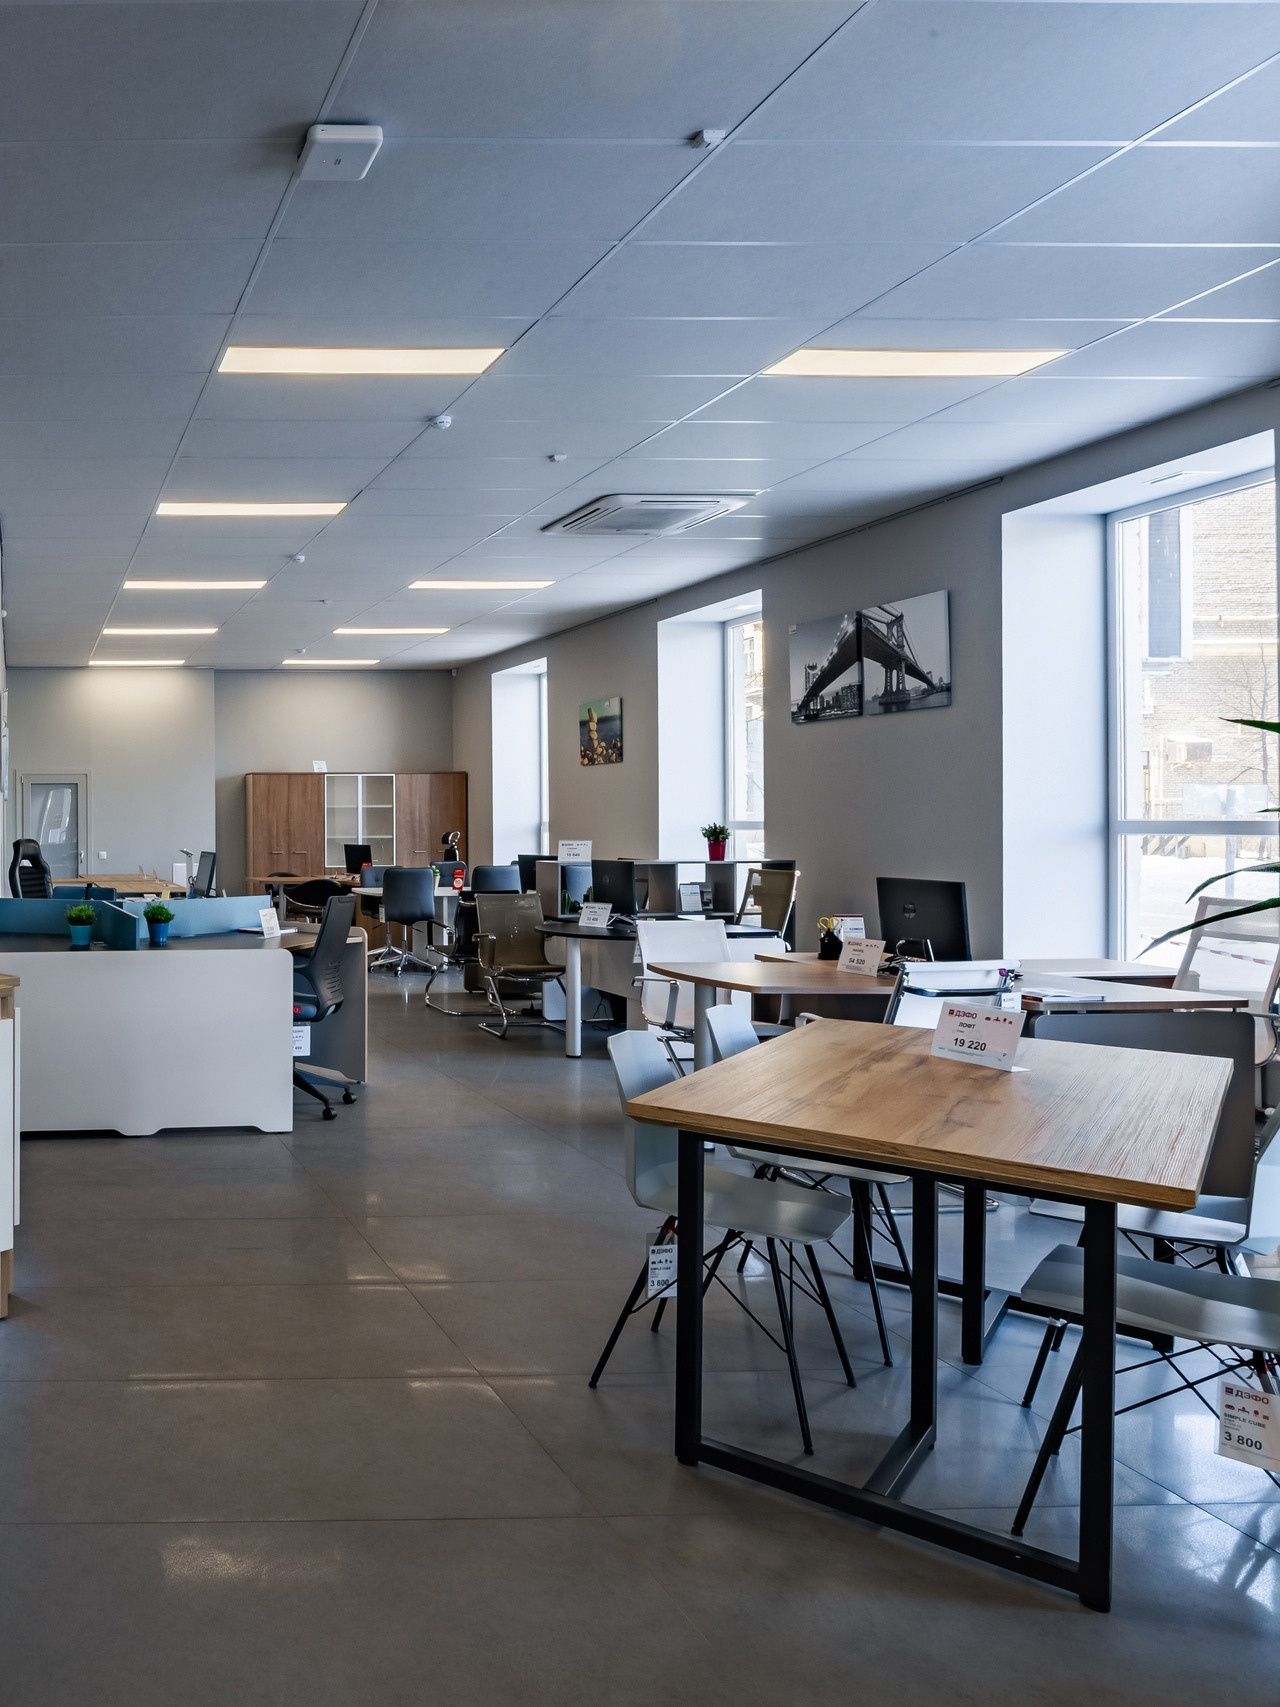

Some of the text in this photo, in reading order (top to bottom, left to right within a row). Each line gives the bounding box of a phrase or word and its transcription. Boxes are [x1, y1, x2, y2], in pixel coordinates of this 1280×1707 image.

[954, 1010, 978, 1020] ДЭФО
[958, 1021, 976, 1029] ЛОФТ
[953, 1037, 987, 1052] 19 220
[656, 1279, 670, 1287] 800
[1235, 1389, 1270, 1405] ДЭФО
[1223, 1412, 1247, 1424] SIMPLE
[1248, 1419, 1267, 1429] CUBE
[1224, 1431, 1232, 1441] 3
[1237, 1435, 1263, 1451] 800
